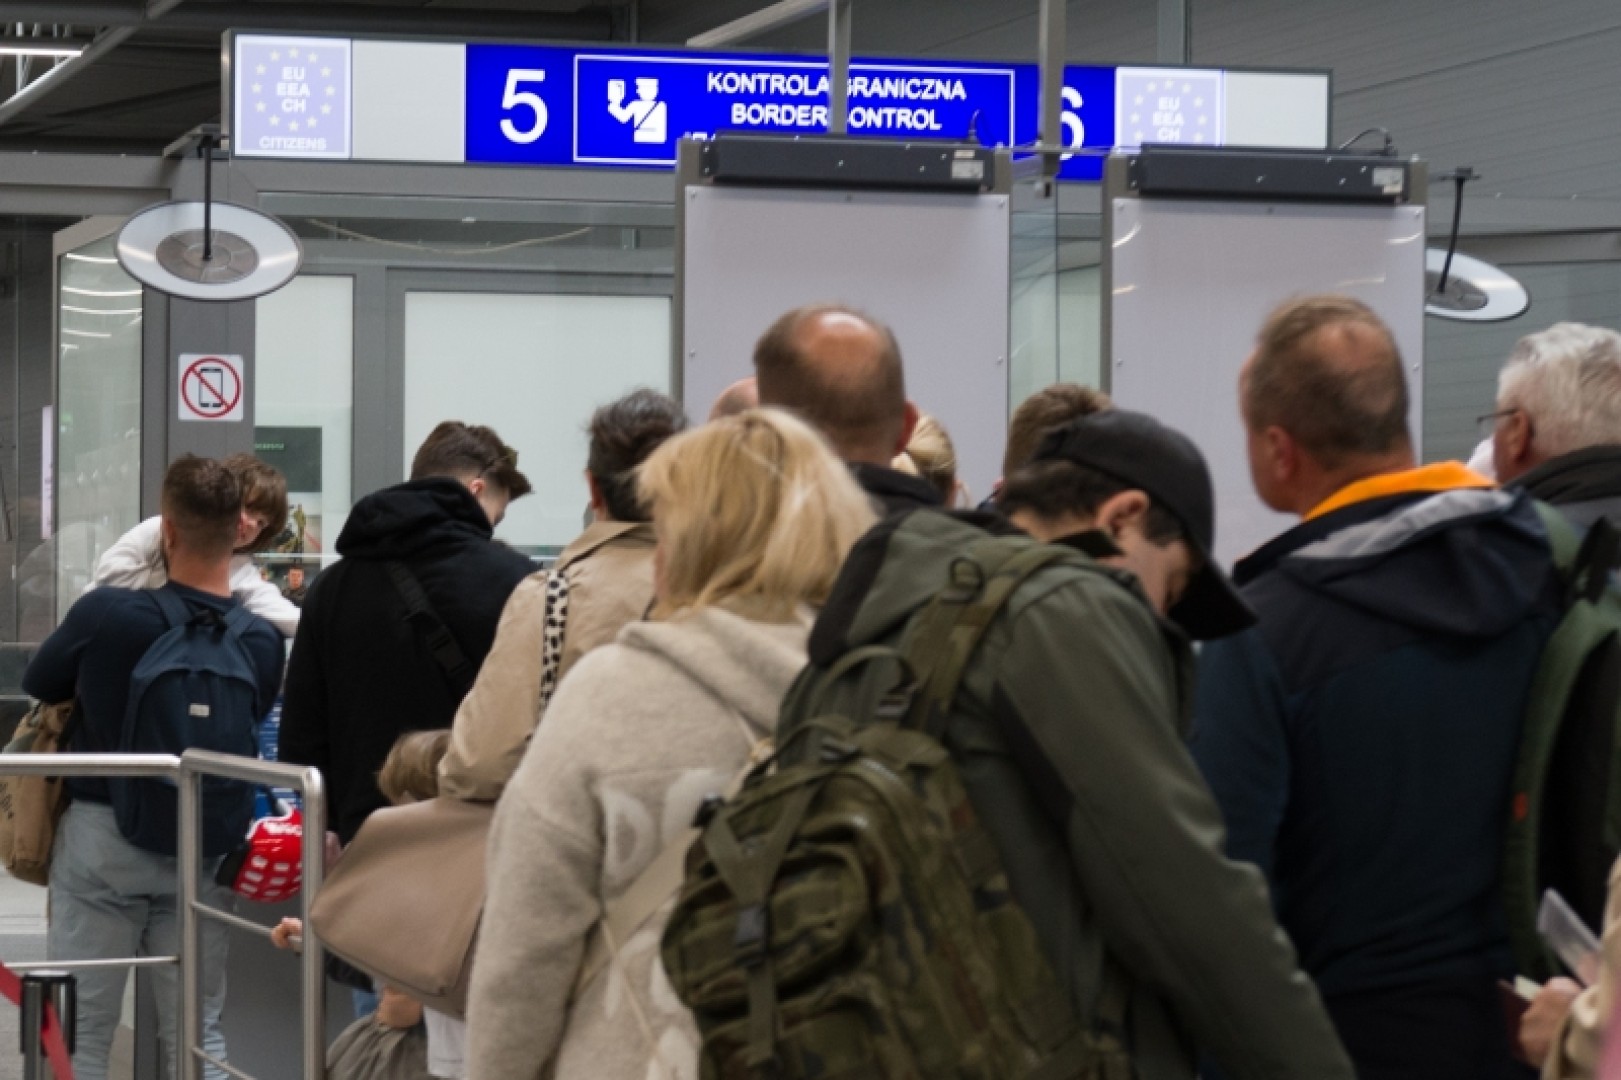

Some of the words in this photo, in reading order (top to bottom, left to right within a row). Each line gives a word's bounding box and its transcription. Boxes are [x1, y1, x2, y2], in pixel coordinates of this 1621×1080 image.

[282, 67, 305, 80] EU
[276, 83, 310, 97] EEA
[707, 71, 830, 96] KONTROLA
[281, 99, 306, 113] CH
[500, 68, 548, 144] 5
[1158, 97, 1180, 110] EU
[731, 102, 829, 126] BORDER
[847, 106, 942, 130] ONTROL
[1152, 112, 1184, 126] EEA
[1157, 127, 1180, 142] CH
[259, 136, 327, 151] CITIZENS
